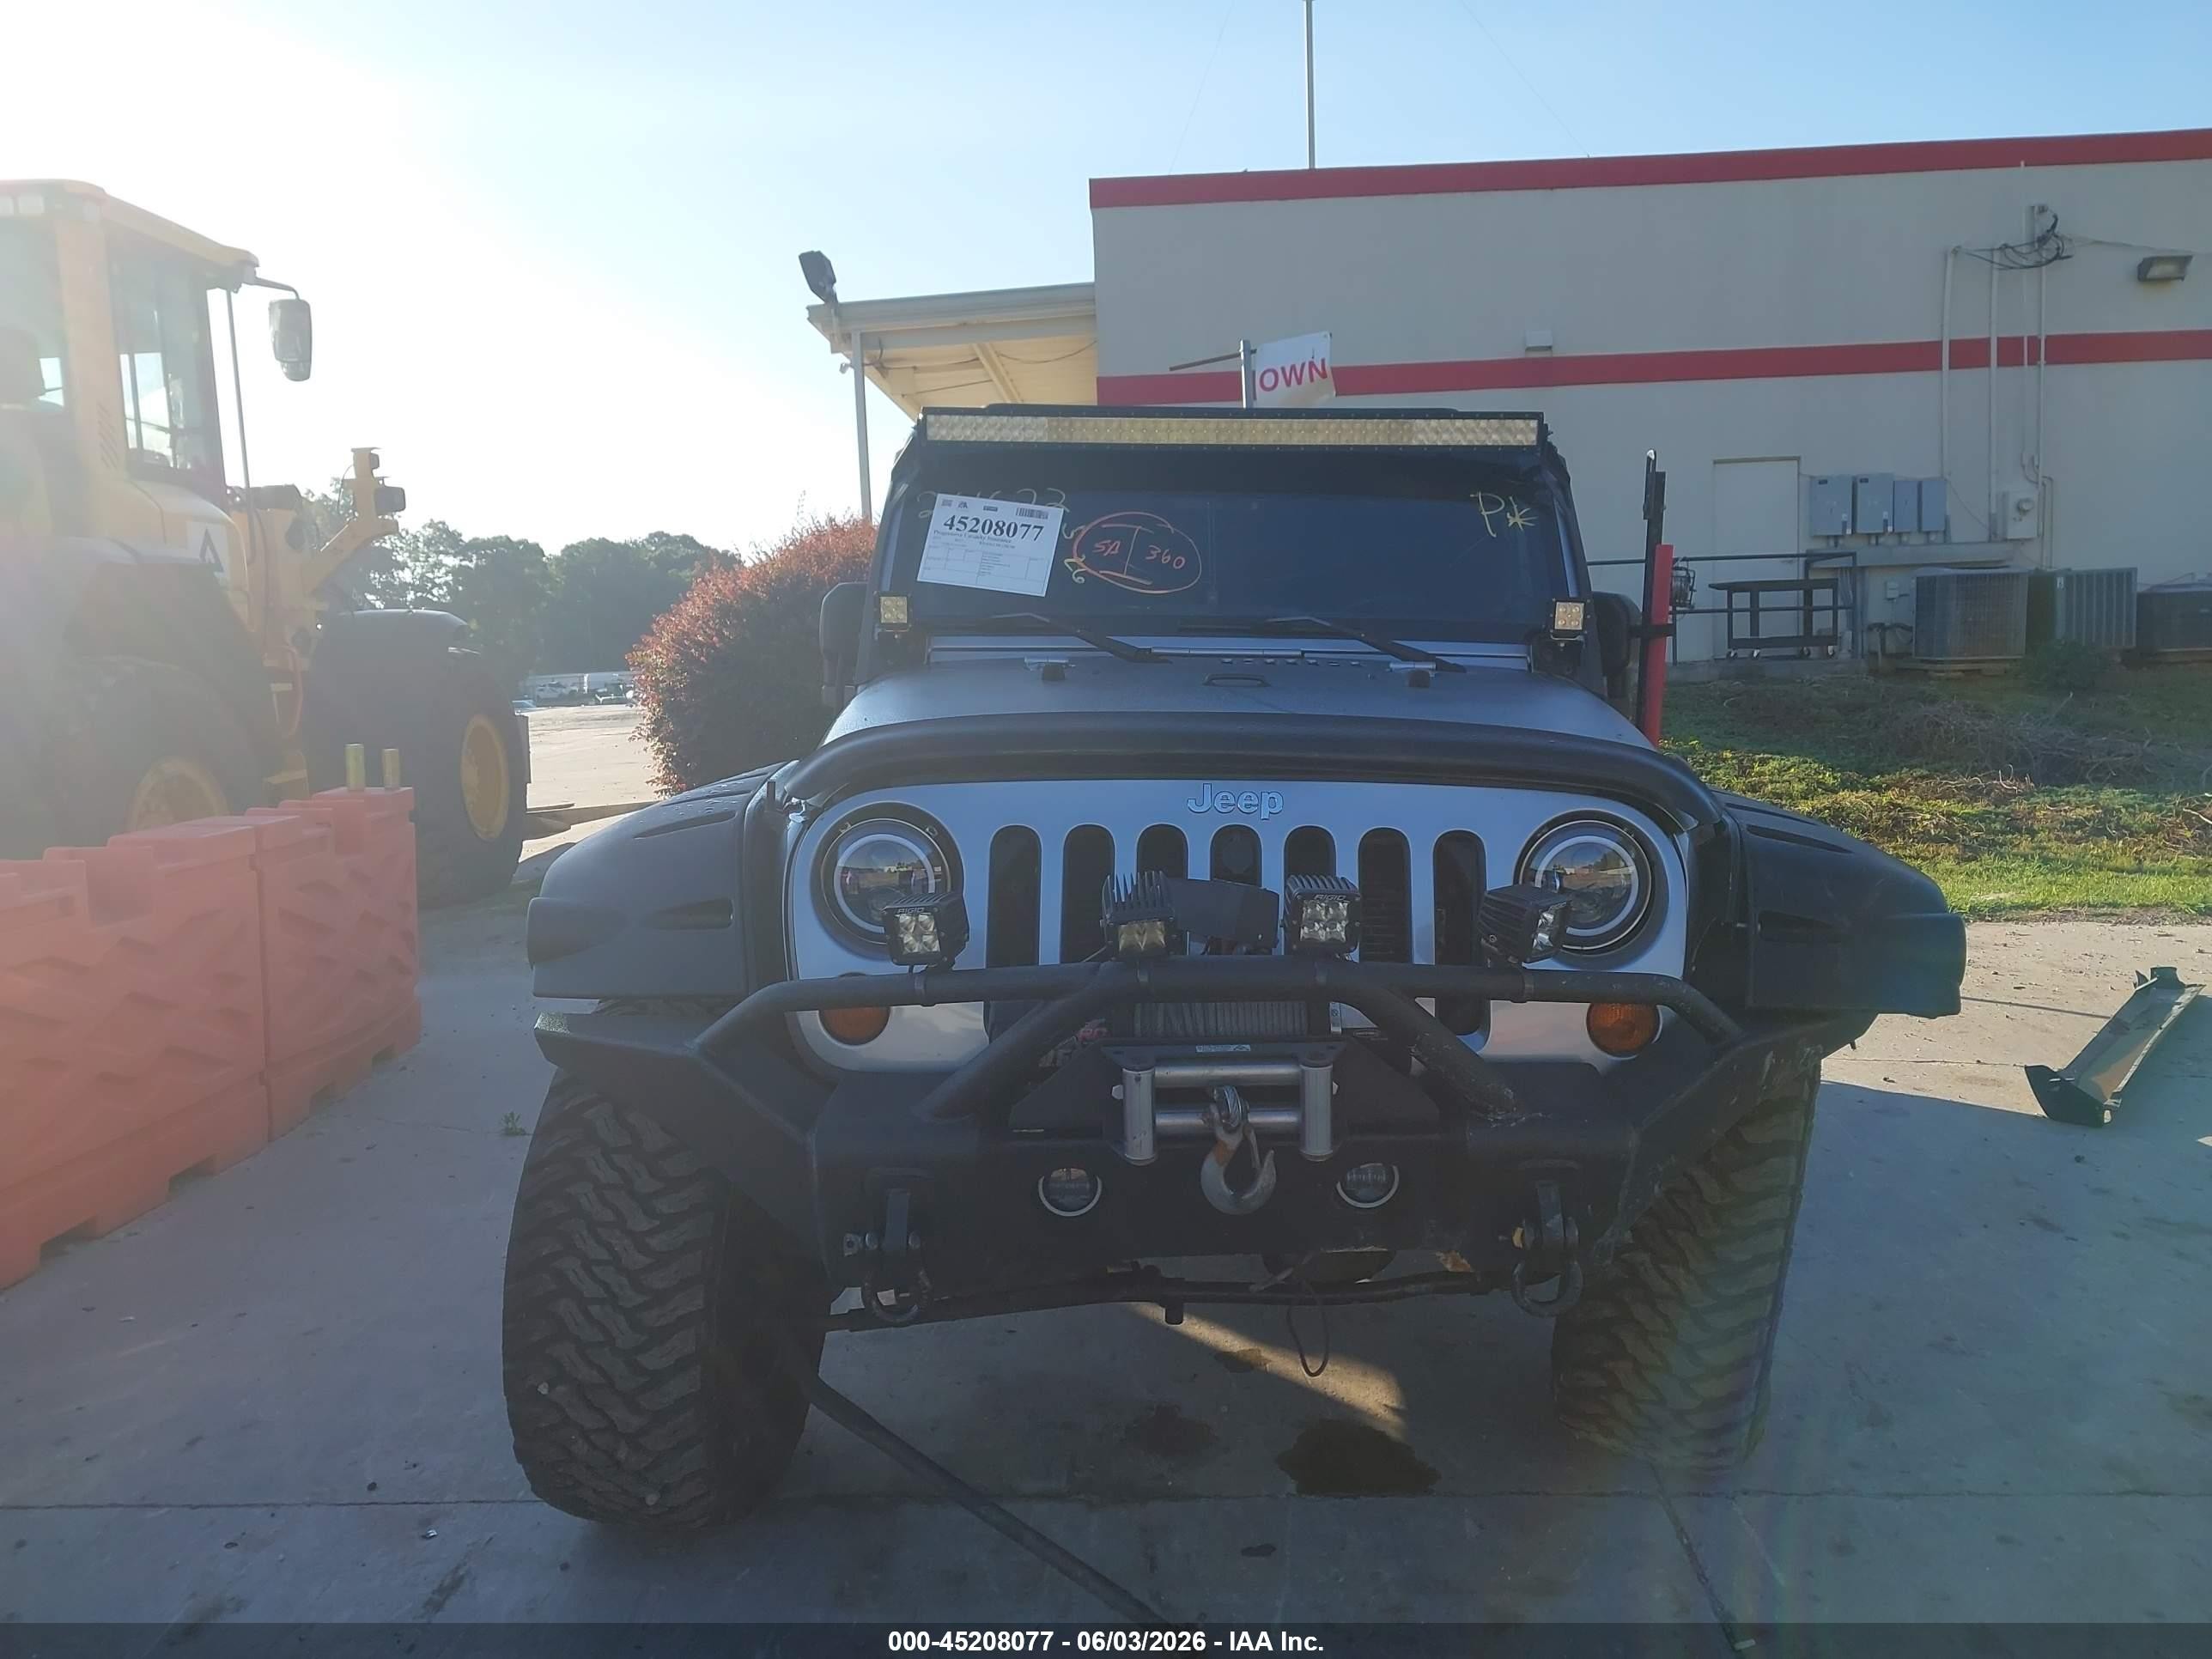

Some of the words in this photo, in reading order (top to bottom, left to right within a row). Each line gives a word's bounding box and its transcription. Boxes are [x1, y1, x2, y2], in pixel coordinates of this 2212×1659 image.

[1259, 357, 1328, 392] OWN
[944, 514, 1045, 541] 45208077
[1146, 544, 1186, 569] 360
[1188, 783, 1284, 820] Jeep
